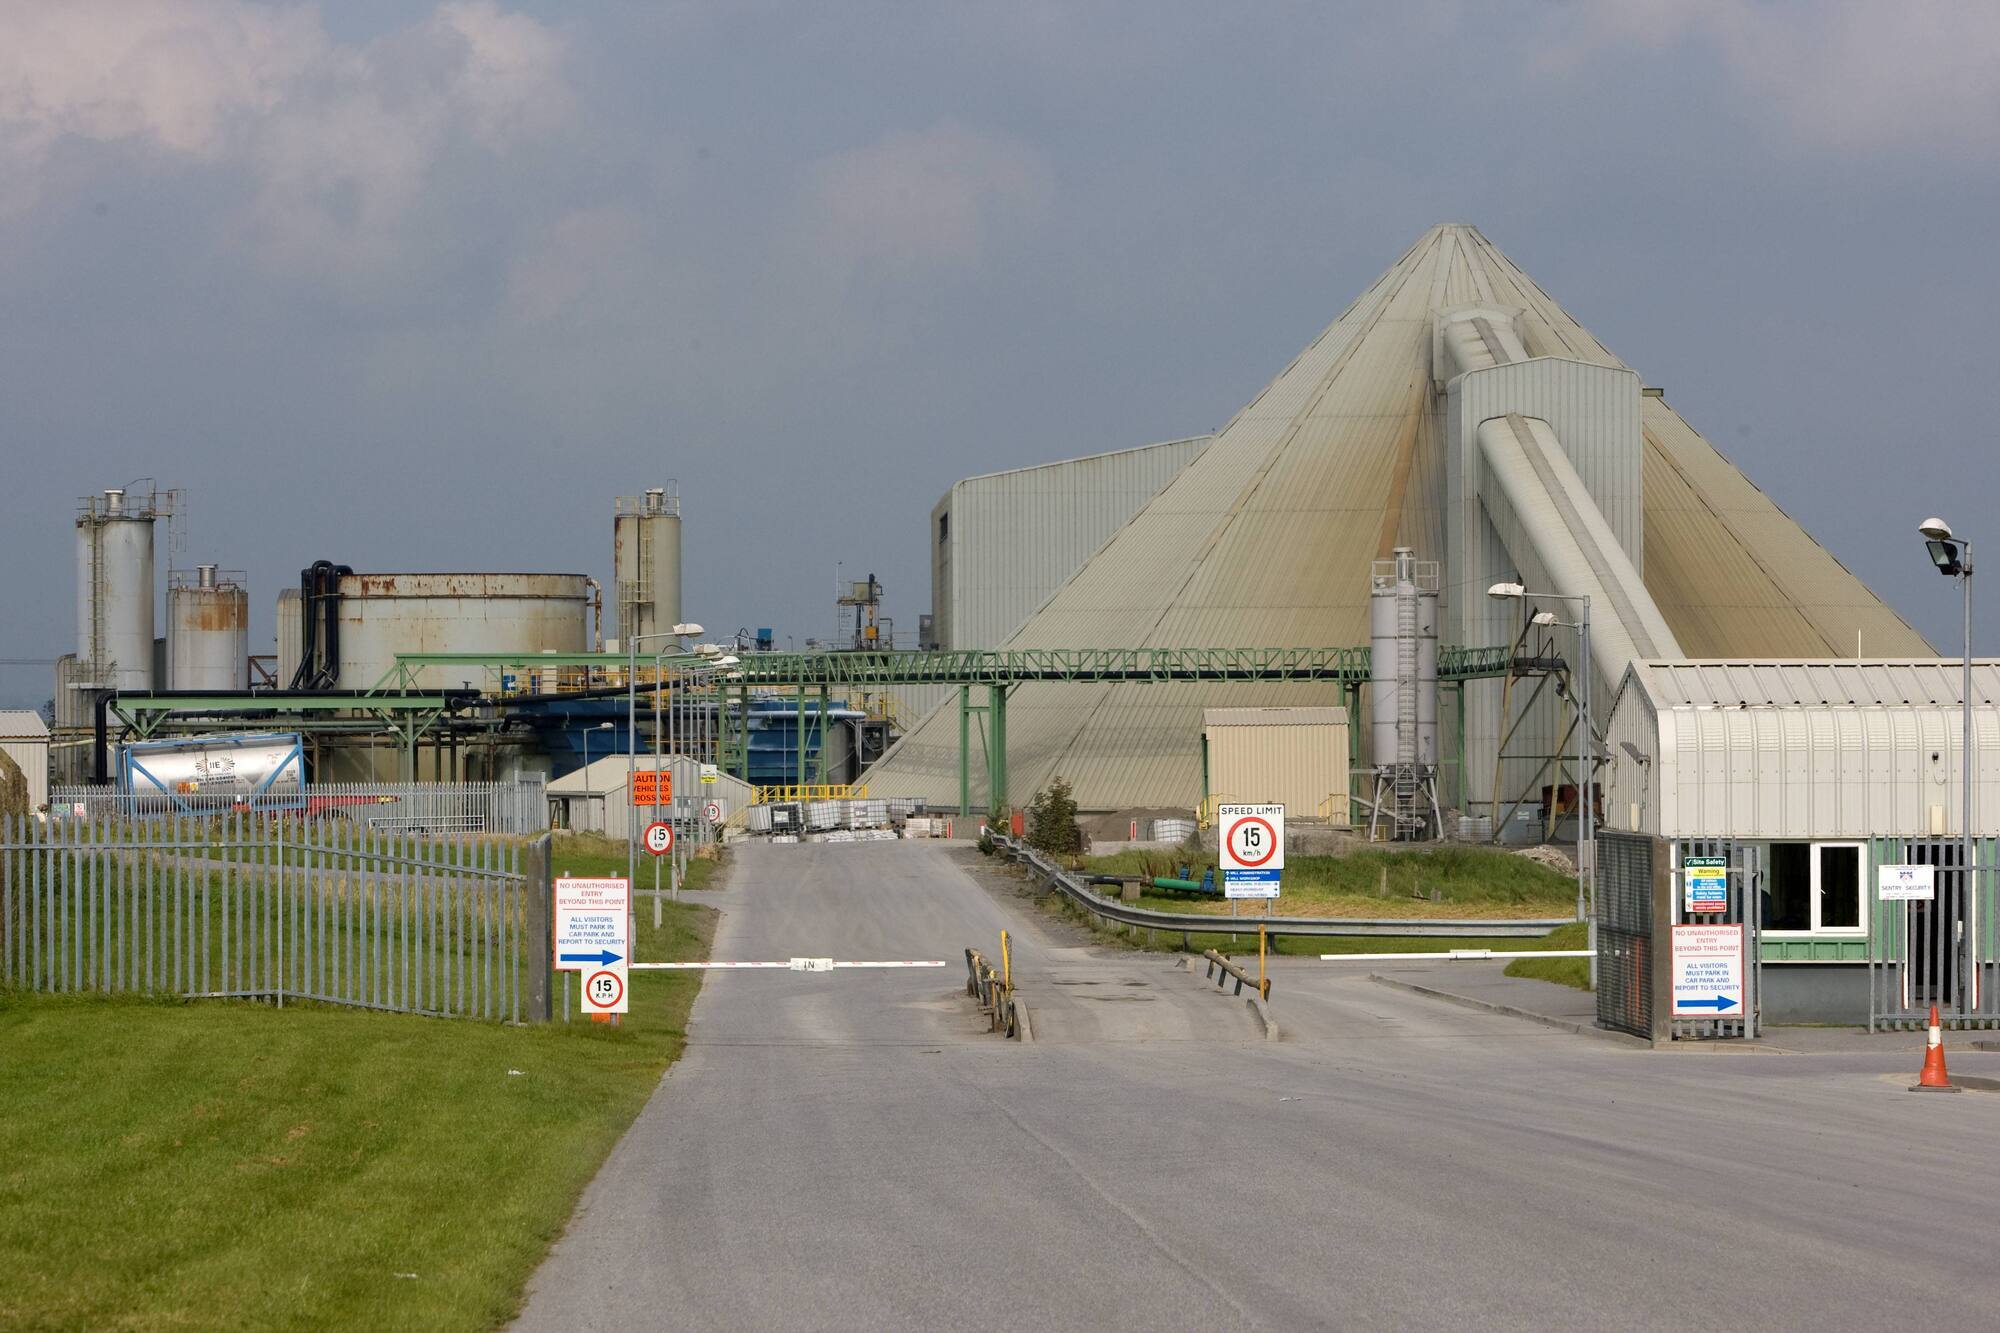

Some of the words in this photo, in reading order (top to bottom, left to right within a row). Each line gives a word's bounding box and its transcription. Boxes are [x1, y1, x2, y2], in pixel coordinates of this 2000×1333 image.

[634, 775, 671, 783] AUTION
[634, 794, 671, 802] ROSSNG
[1221, 807, 1253, 815] SPEED
[1256, 806, 1282, 815] LIMIT
[653, 828, 667, 841] 15
[1243, 827, 1260, 847] 15
[1242, 849, 1261, 857] km/h
[1705, 858, 1725, 866] Safety
[1697, 868, 1720, 876] Warning
[803, 961, 815, 969] IN
[596, 979, 612, 992] 15
